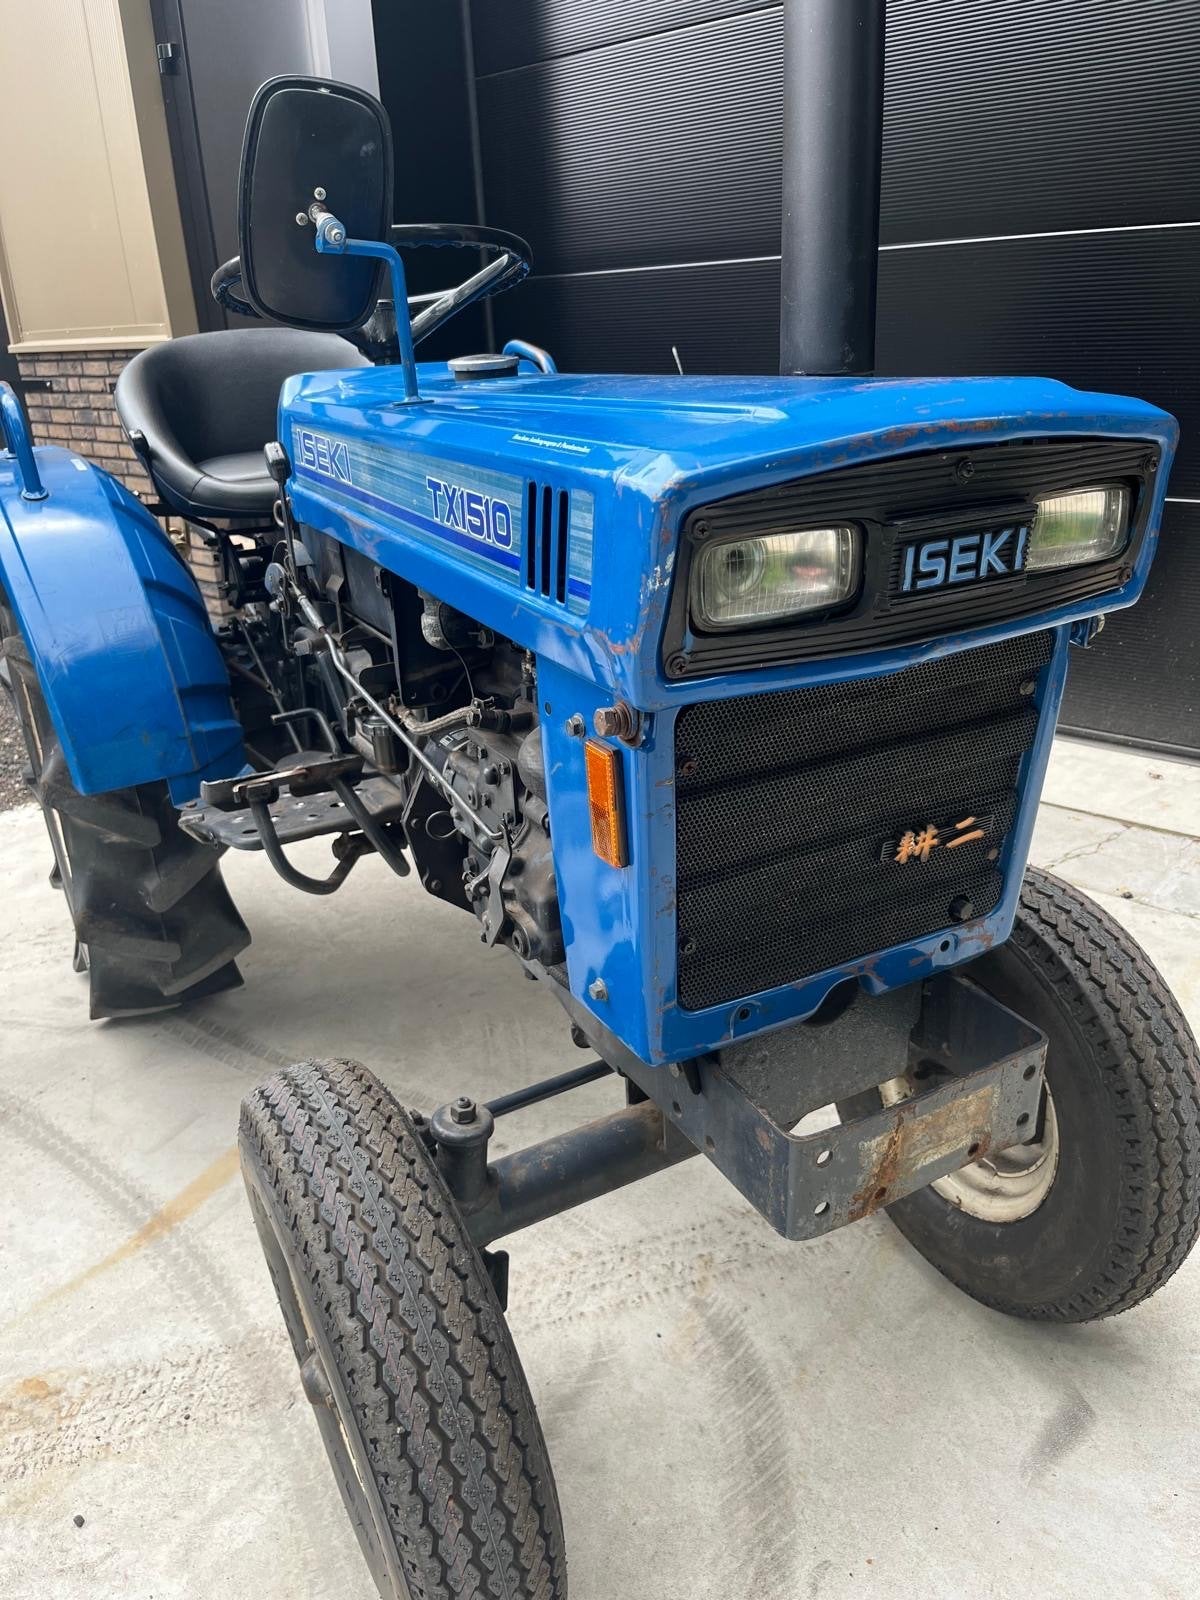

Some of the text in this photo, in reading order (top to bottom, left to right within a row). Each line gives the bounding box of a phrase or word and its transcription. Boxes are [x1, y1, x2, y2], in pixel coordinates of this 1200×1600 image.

[296, 428, 353, 486] ISEKI
[425, 475, 513, 550] TX1510
[902, 527, 1028, 592] ISEKI
